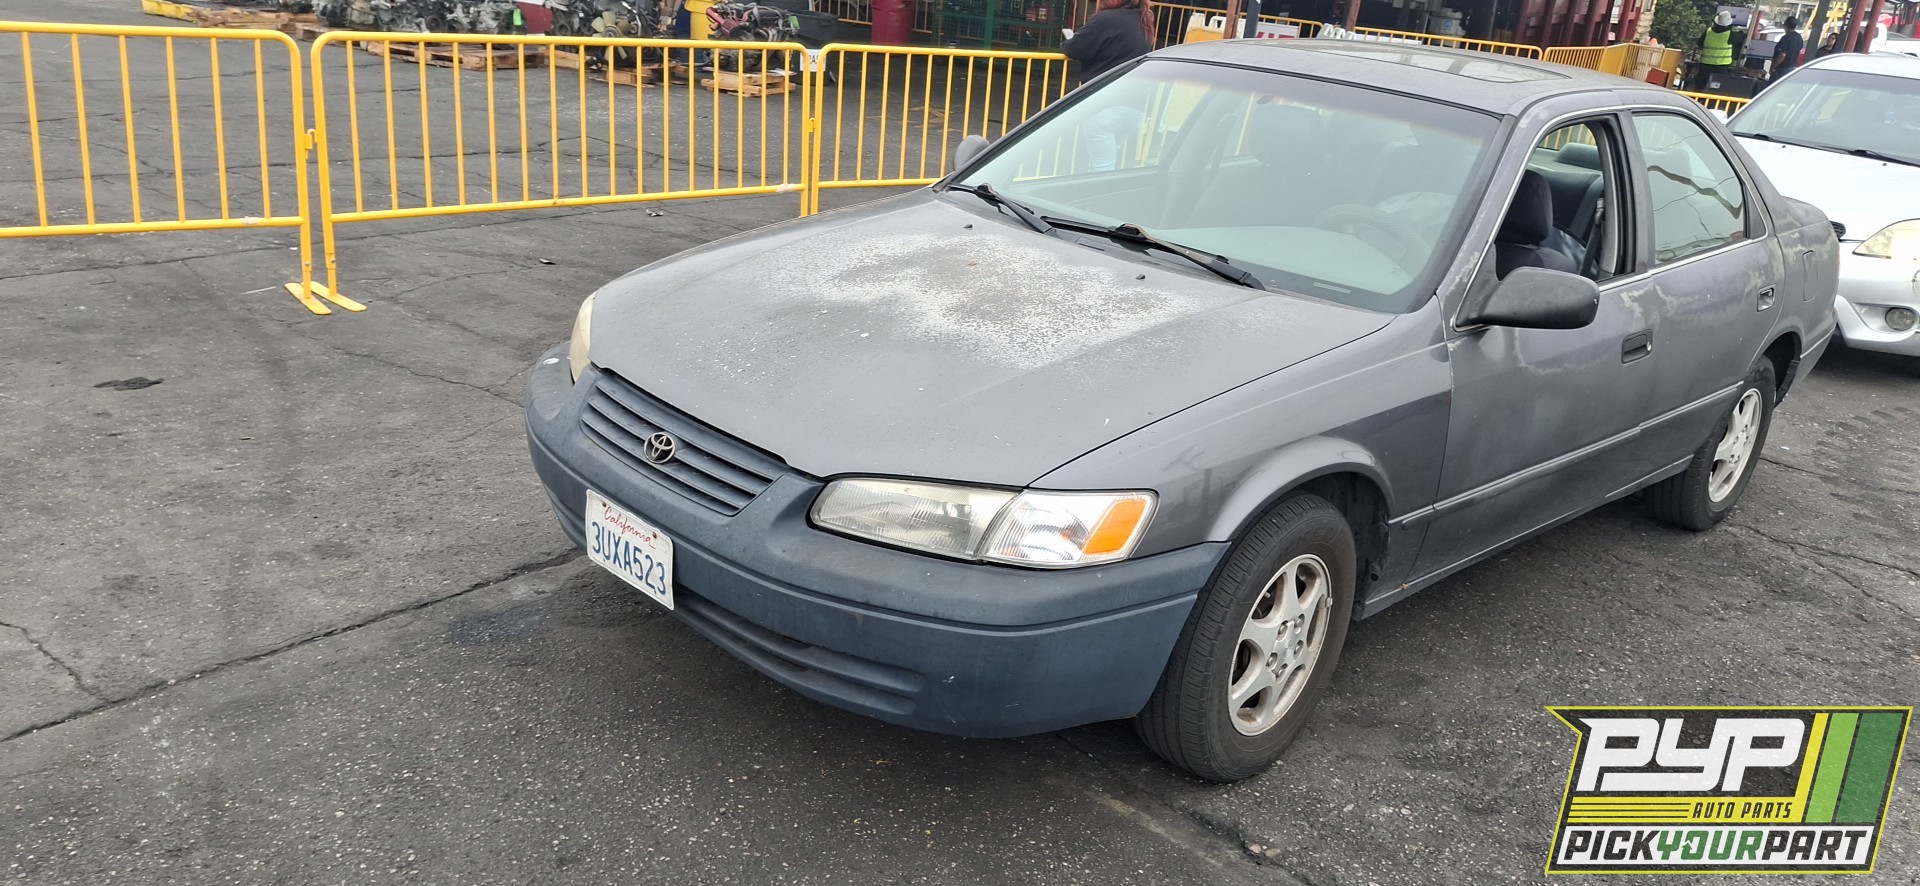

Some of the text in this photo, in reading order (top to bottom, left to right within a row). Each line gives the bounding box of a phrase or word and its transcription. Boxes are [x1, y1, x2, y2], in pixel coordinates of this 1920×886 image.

[1843, 7, 1854, 31] EXIT
[604, 506, 656, 549] California
[591, 521, 667, 596] 3UXA523
